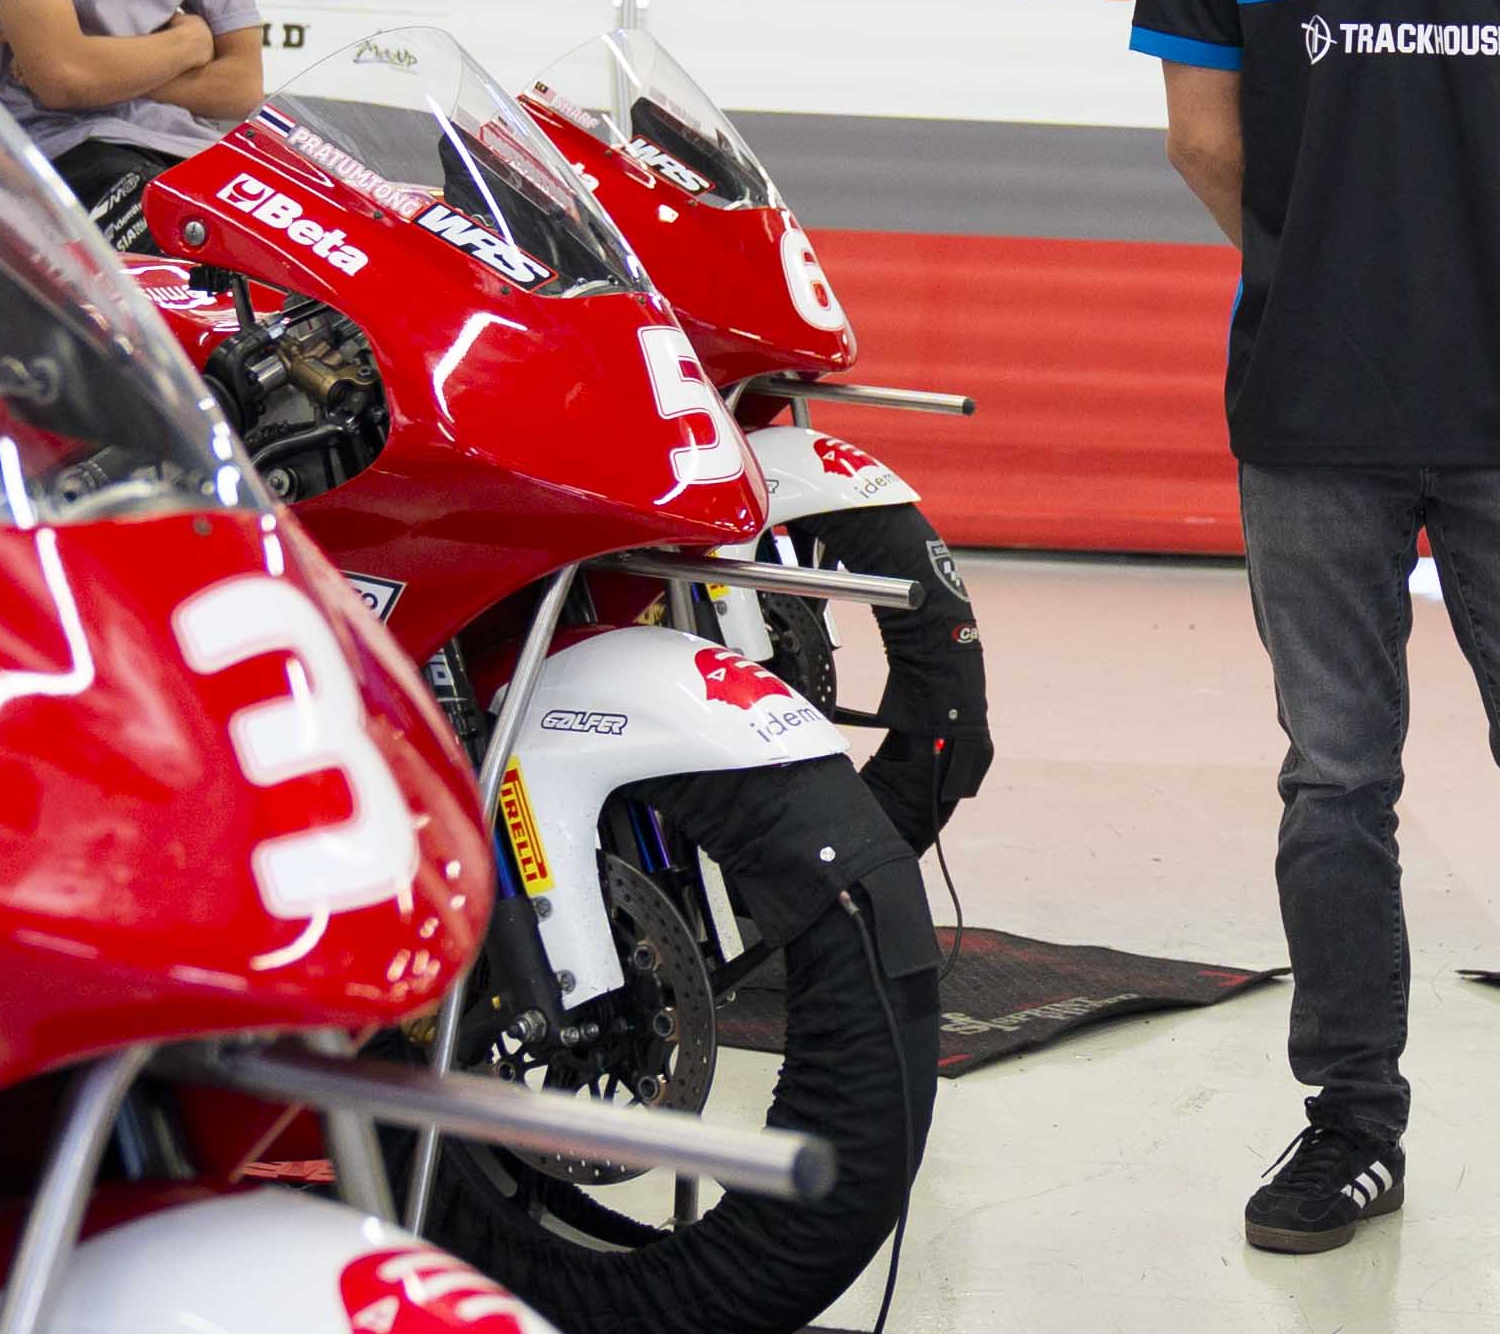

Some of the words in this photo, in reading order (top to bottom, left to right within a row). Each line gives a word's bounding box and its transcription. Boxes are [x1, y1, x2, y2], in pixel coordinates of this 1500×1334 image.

[289, 127, 424, 221] PRATUMTONG
[626, 138, 711, 193] WRS
[255, 189, 369, 276] Beta
[417, 208, 550, 283] WRS
[780, 226, 845, 331] 6
[639, 325, 746, 484] 5
[170, 572, 417, 920] 3
[541, 709, 628, 735] GALFER
[749, 704, 818, 744] idem
[501, 763, 547, 885] PIRELLI
